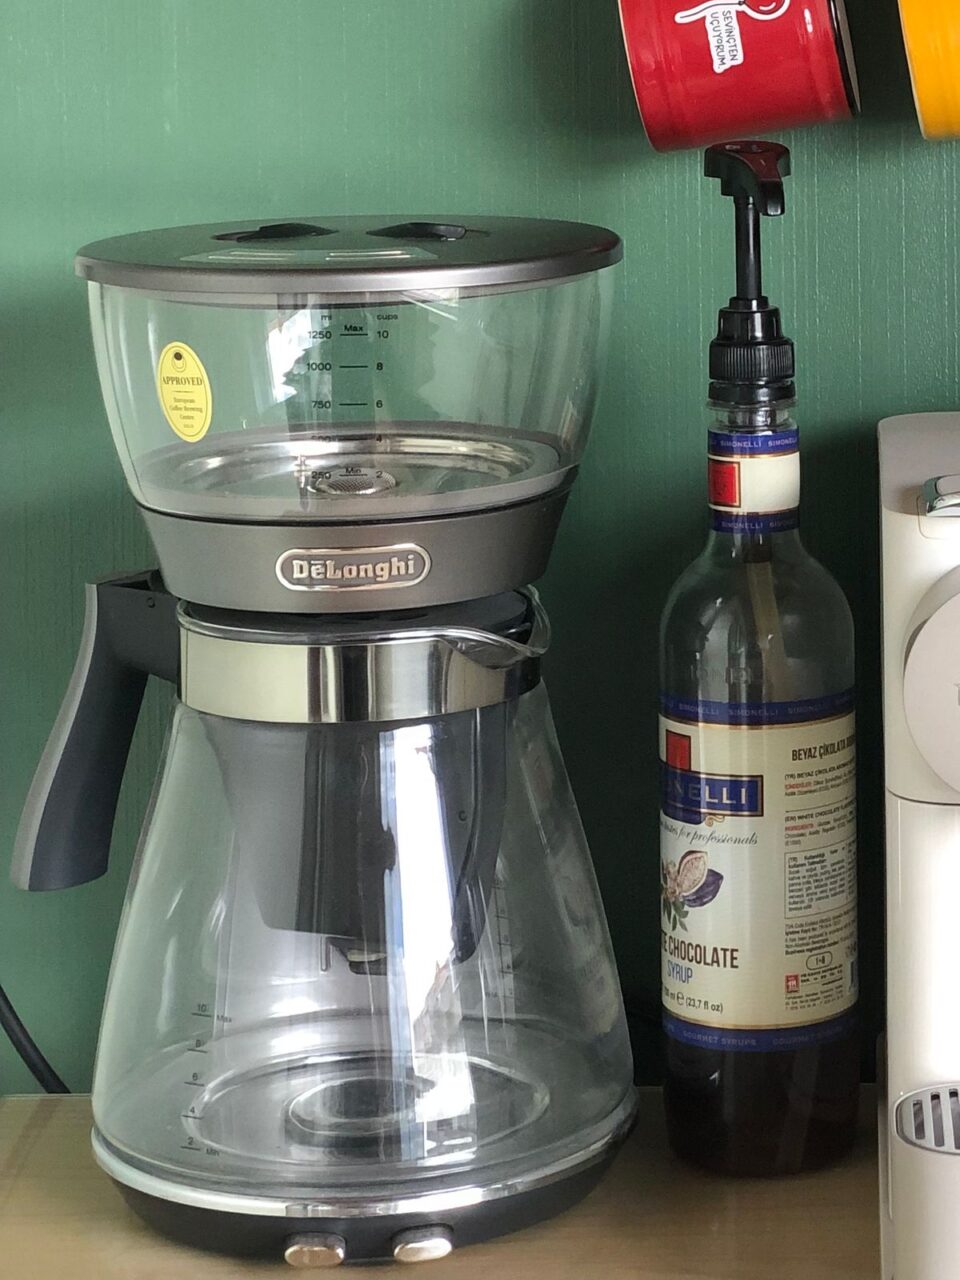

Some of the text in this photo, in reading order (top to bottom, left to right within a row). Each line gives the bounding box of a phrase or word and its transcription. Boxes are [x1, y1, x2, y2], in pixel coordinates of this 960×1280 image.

[344, 324, 364, 332] Max
[308, 330, 332, 339] 1250
[377, 330, 389, 339] 10
[306, 362, 332, 371] 1000
[376, 362, 384, 371] 8
[312, 400, 331, 409] 750
[376, 400, 383, 409] 6
[791, 746, 817, 761] BEYAZ
[669, 935, 739, 968] CHOCOLATE
[667, 959, 693, 984] SYRUP
